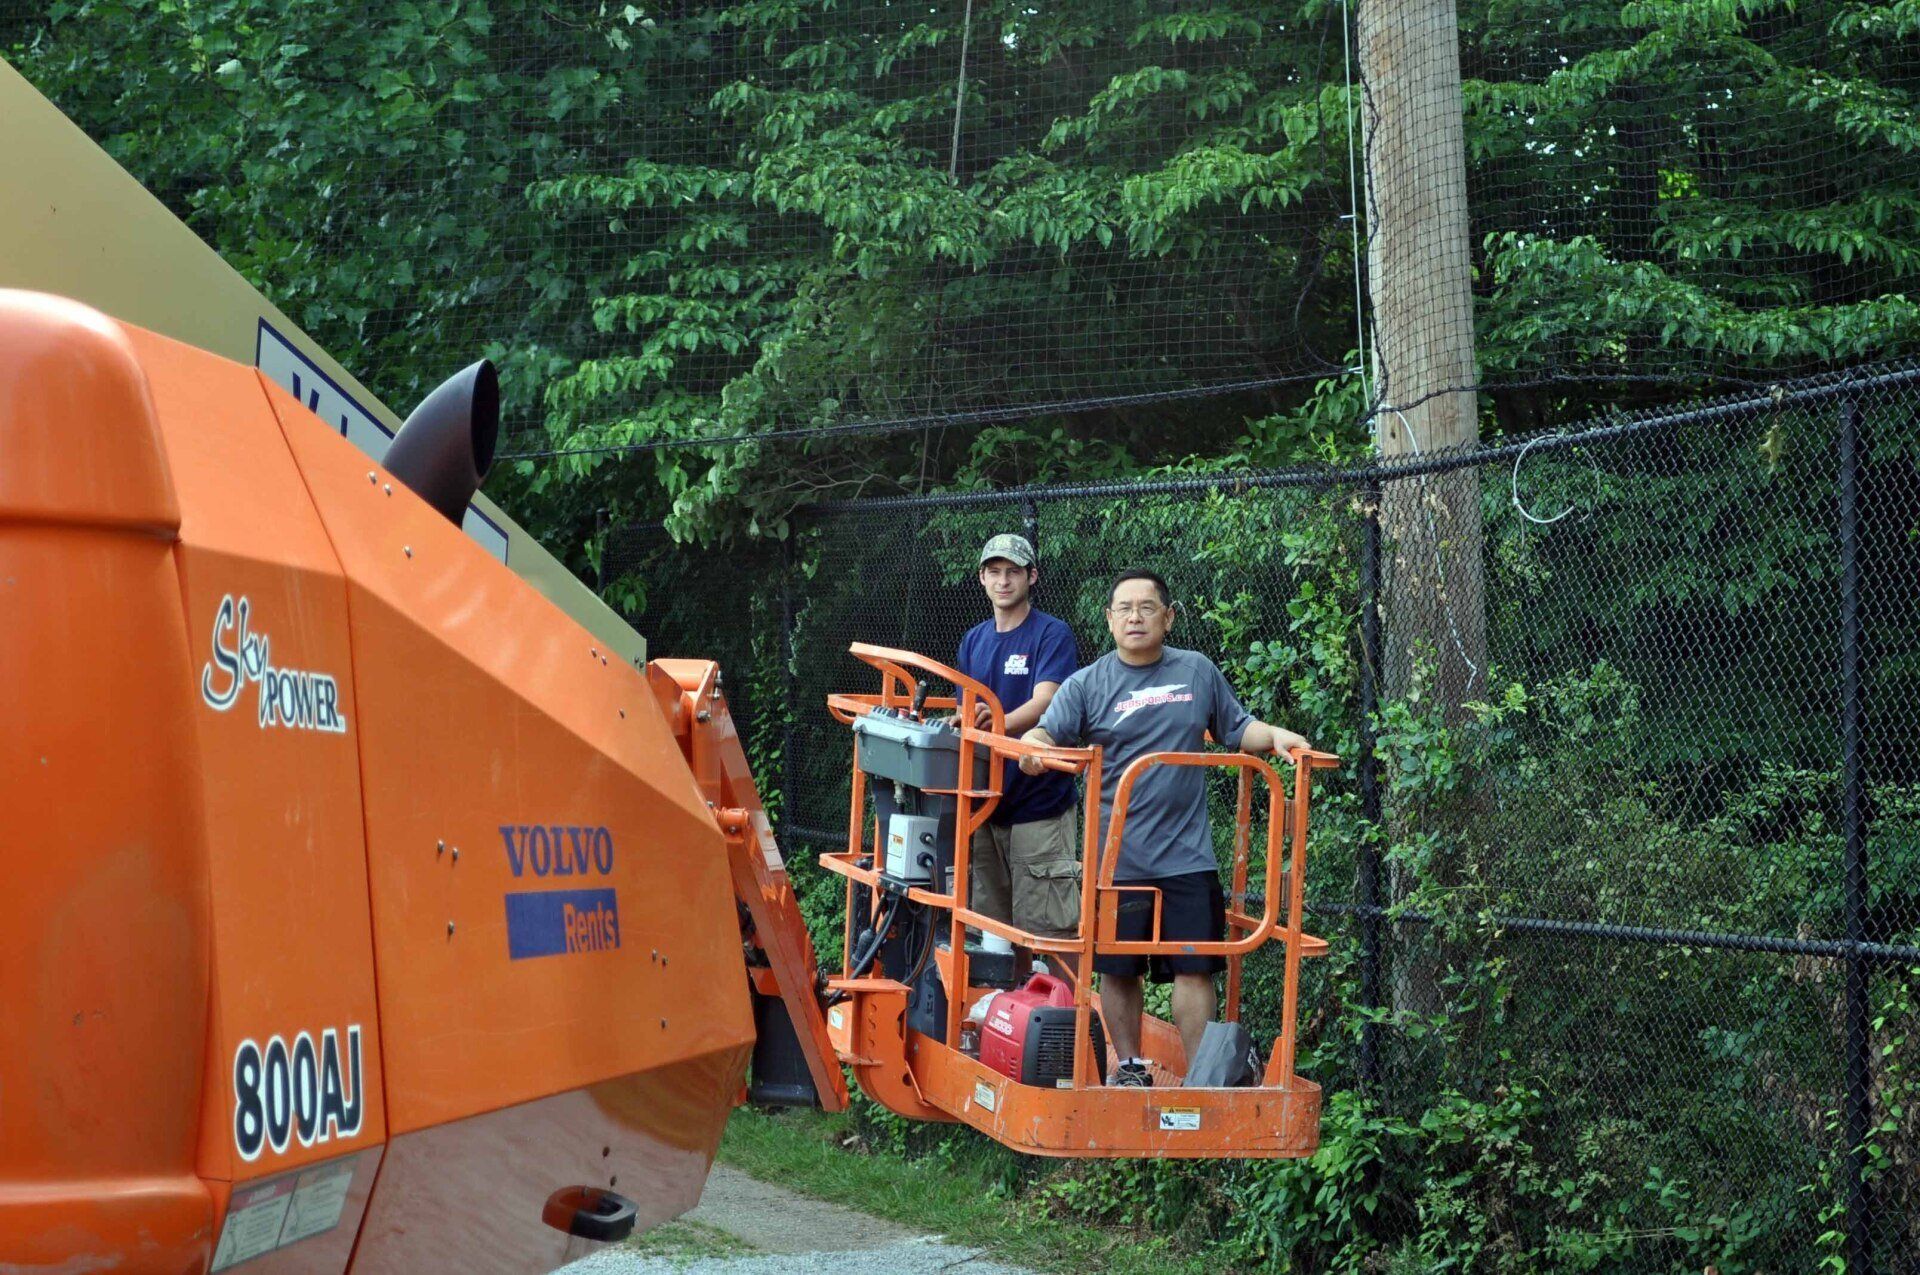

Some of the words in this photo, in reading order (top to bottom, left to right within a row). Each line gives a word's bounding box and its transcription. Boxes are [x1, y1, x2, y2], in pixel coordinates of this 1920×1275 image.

[203, 594, 268, 728] Sky
[265, 667, 341, 730] POWER
[499, 825, 614, 877] VOLVO
[563, 902, 617, 953] Rents
[234, 1025, 362, 1161] 800AJ
